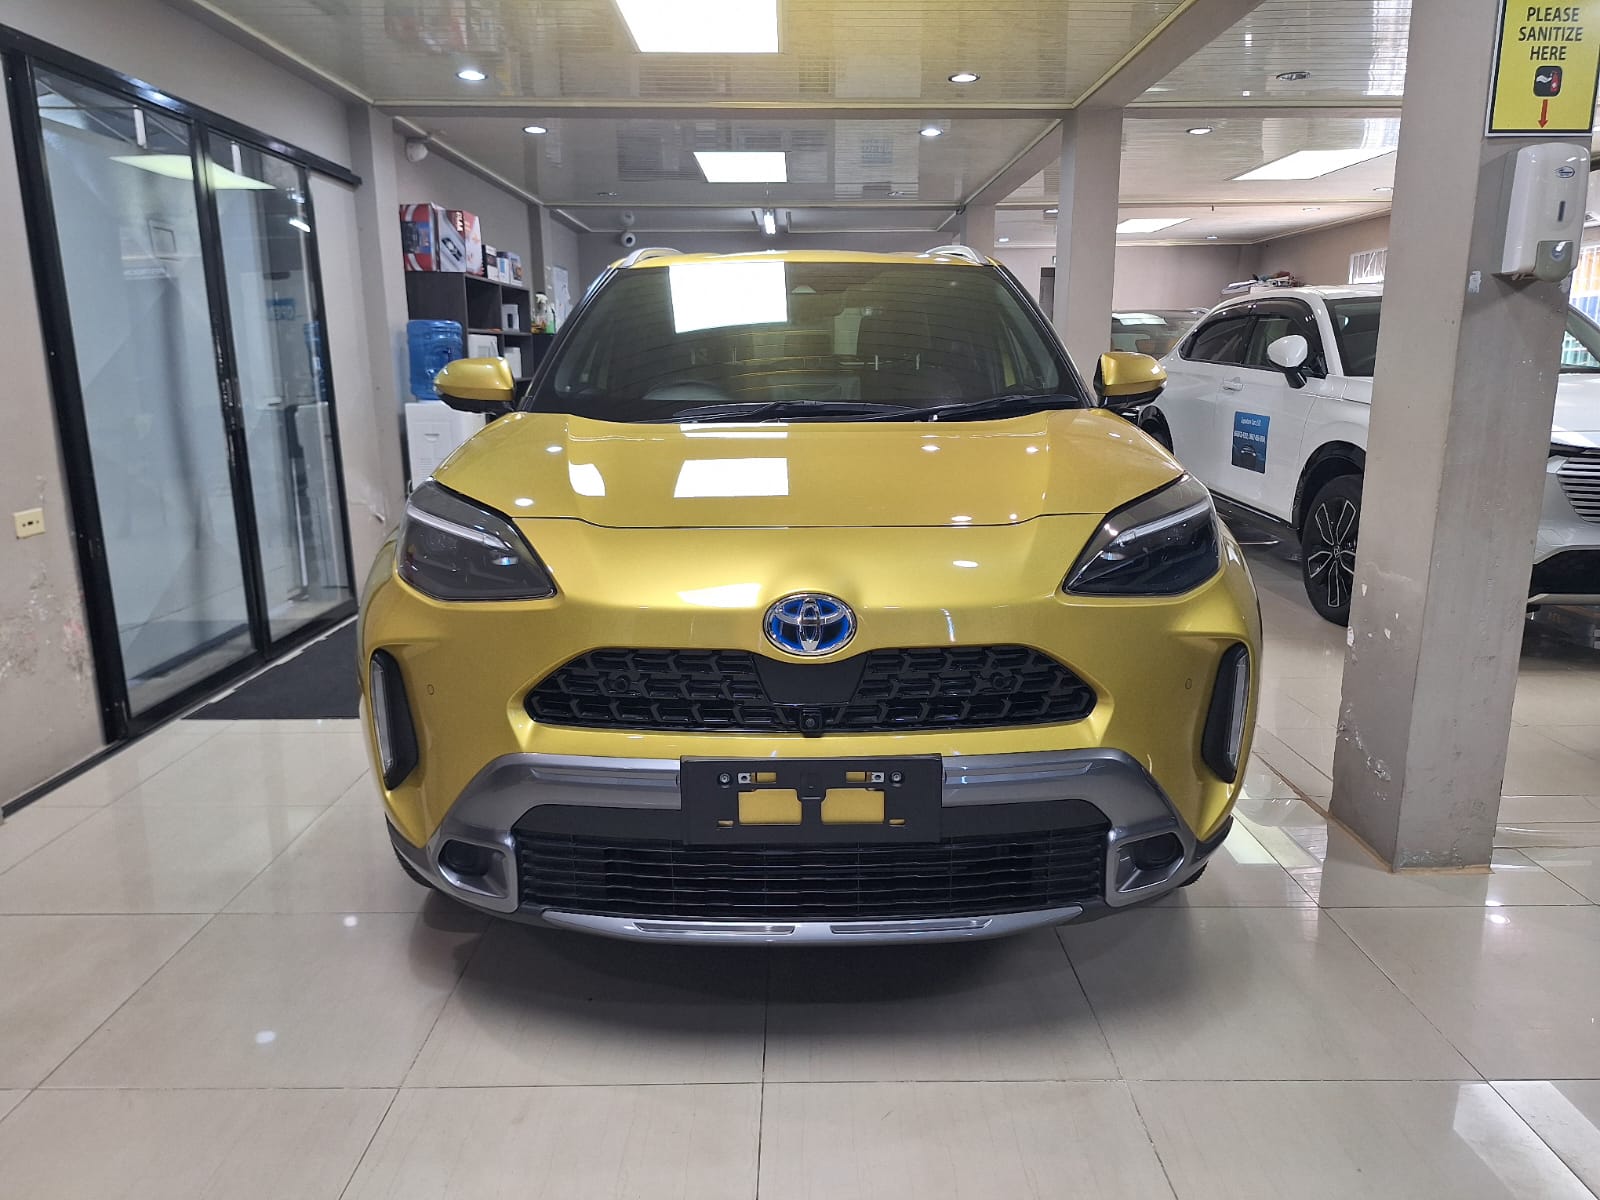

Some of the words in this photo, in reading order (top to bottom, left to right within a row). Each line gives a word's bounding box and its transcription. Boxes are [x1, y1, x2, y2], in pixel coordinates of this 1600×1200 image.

[1527, 7, 1580, 22] PLEASE
[1518, 27, 1584, 42] SANITIZE
[1530, 46, 1567, 60] HERE
